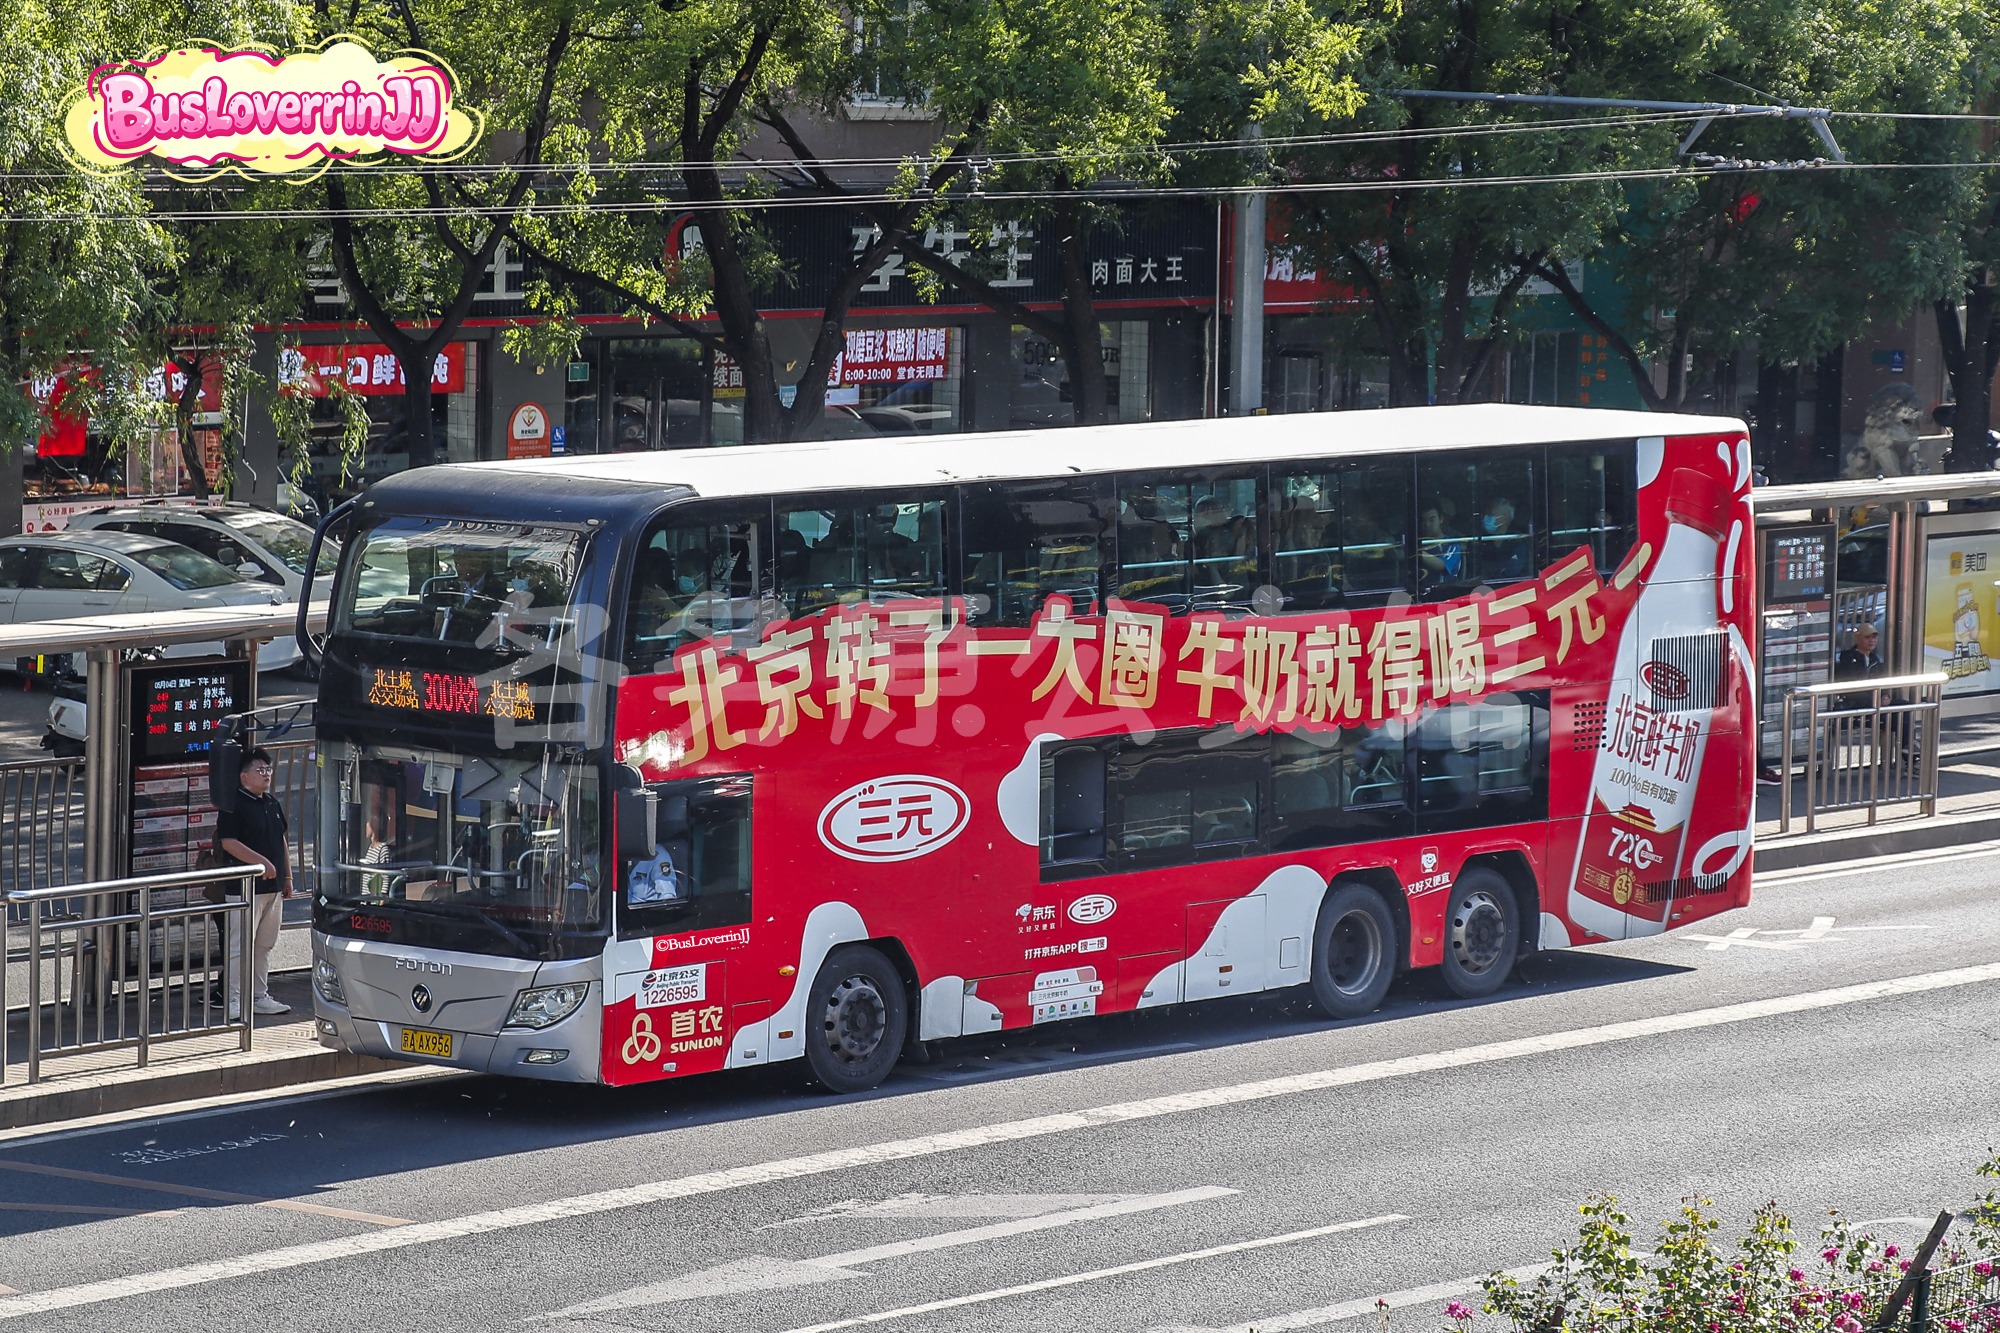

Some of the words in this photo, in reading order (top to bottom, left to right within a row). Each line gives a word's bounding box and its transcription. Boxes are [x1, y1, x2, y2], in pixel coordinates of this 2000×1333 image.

[1092, 257, 1183, 285] 肉面大王
[845, 329, 884, 364] 现磨豆浆
[713, 366, 743, 387] 续面
[845, 367, 892, 382] 6:00-10:00
[896, 364, 944, 380] 堂食无限量
[1965, 553, 1987, 572] 美团
[669, 605, 1164, 767] 北京转了一大圈
[1176, 555, 1607, 723] 牛奶就得喝三元
[375, 668, 413, 690] 北土城
[368, 686, 420, 709] 公交场站
[491, 679, 530, 702] 北土城
[484, 697, 536, 720] 公交场站
[857, 794, 933, 844] 三元
[1032, 905, 1056, 921] 京东
[1080, 901, 1105, 918] 三元
[350, 914, 392, 934] 1226595
[395, 957, 453, 976] FOTON
[657, 968, 700, 982] 北京公交
[643, 984, 699, 1005] 1226595
[670, 1005, 723, 1038] 首农
[670, 1035, 723, 1054] SUNLON
